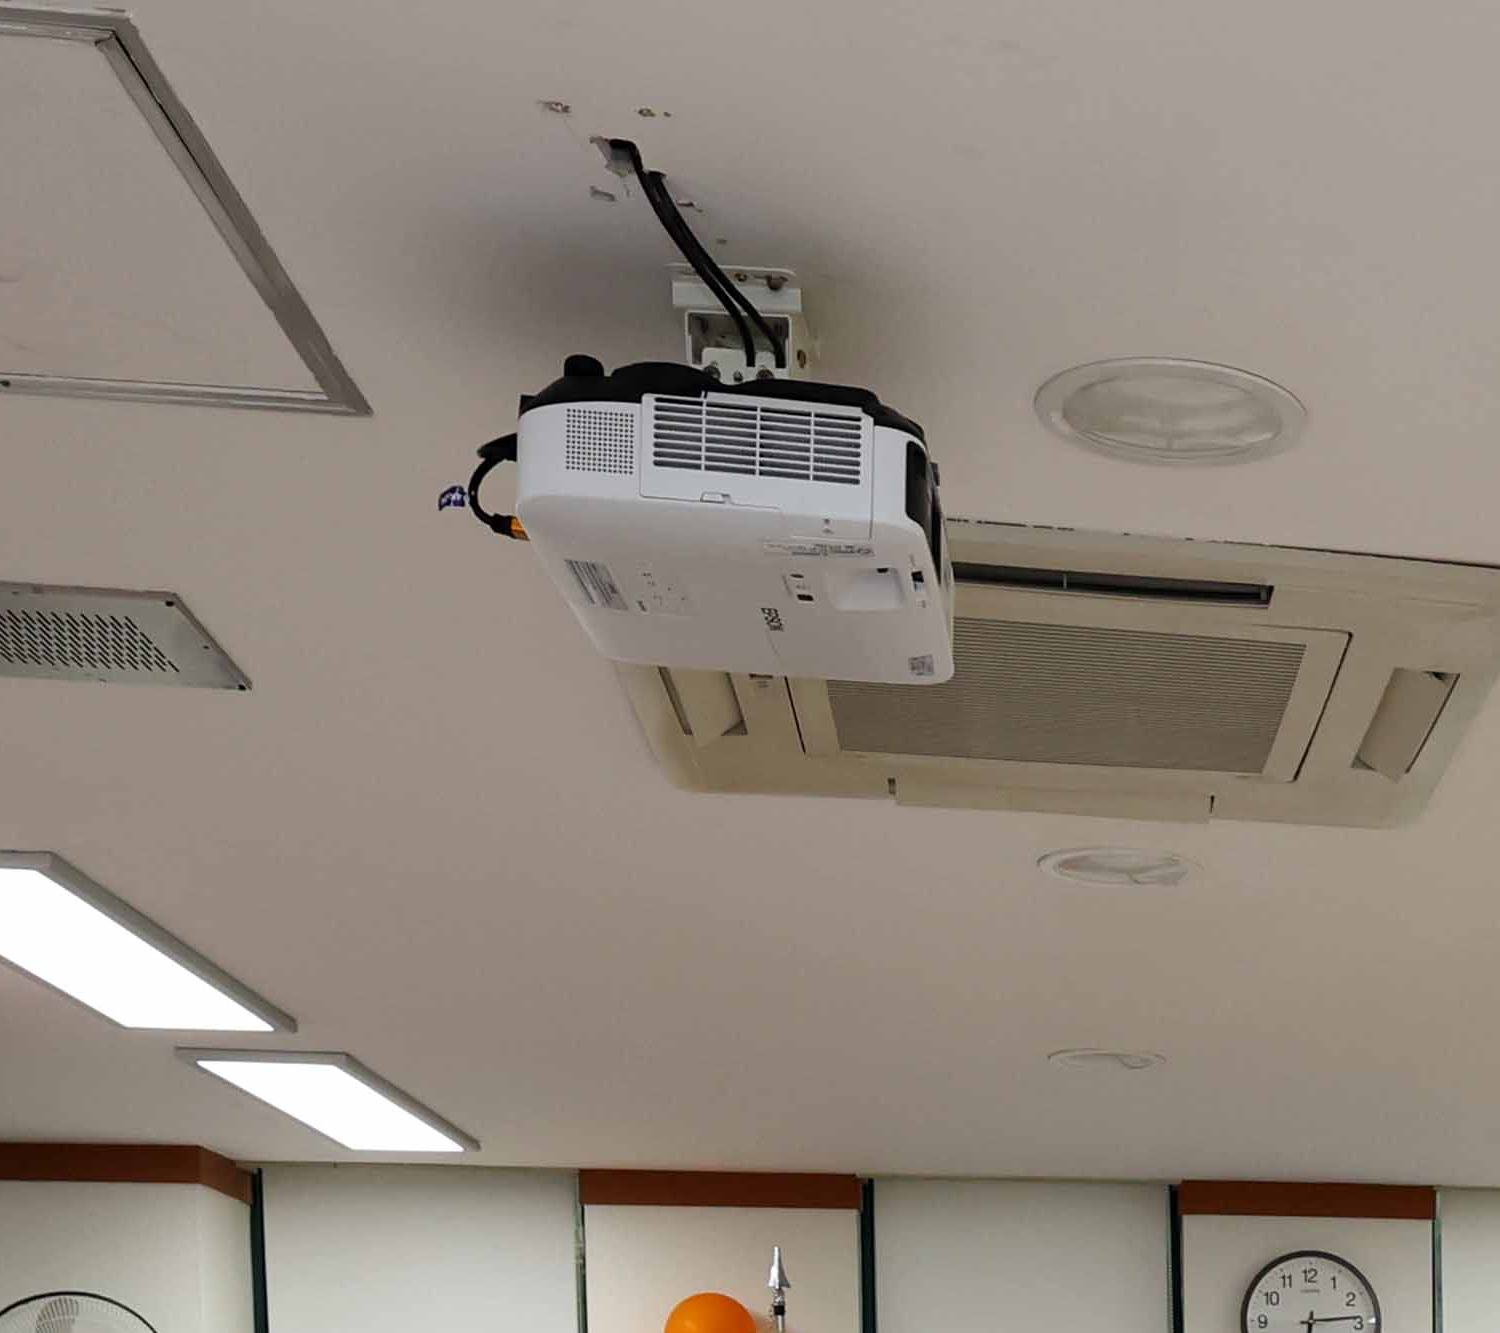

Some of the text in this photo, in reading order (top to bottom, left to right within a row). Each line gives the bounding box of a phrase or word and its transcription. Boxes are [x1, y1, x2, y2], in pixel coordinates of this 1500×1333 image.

[1281, 1275, 1292, 1288] 11
[1301, 1268, 1318, 1283] 12
[1331, 1276, 1337, 1289] 1
[1264, 1291, 1280, 1306] 10
[1345, 1292, 1356, 1306] 2
[1257, 1315, 1268, 1328] 9
[1353, 1316, 1364, 1330] 3
